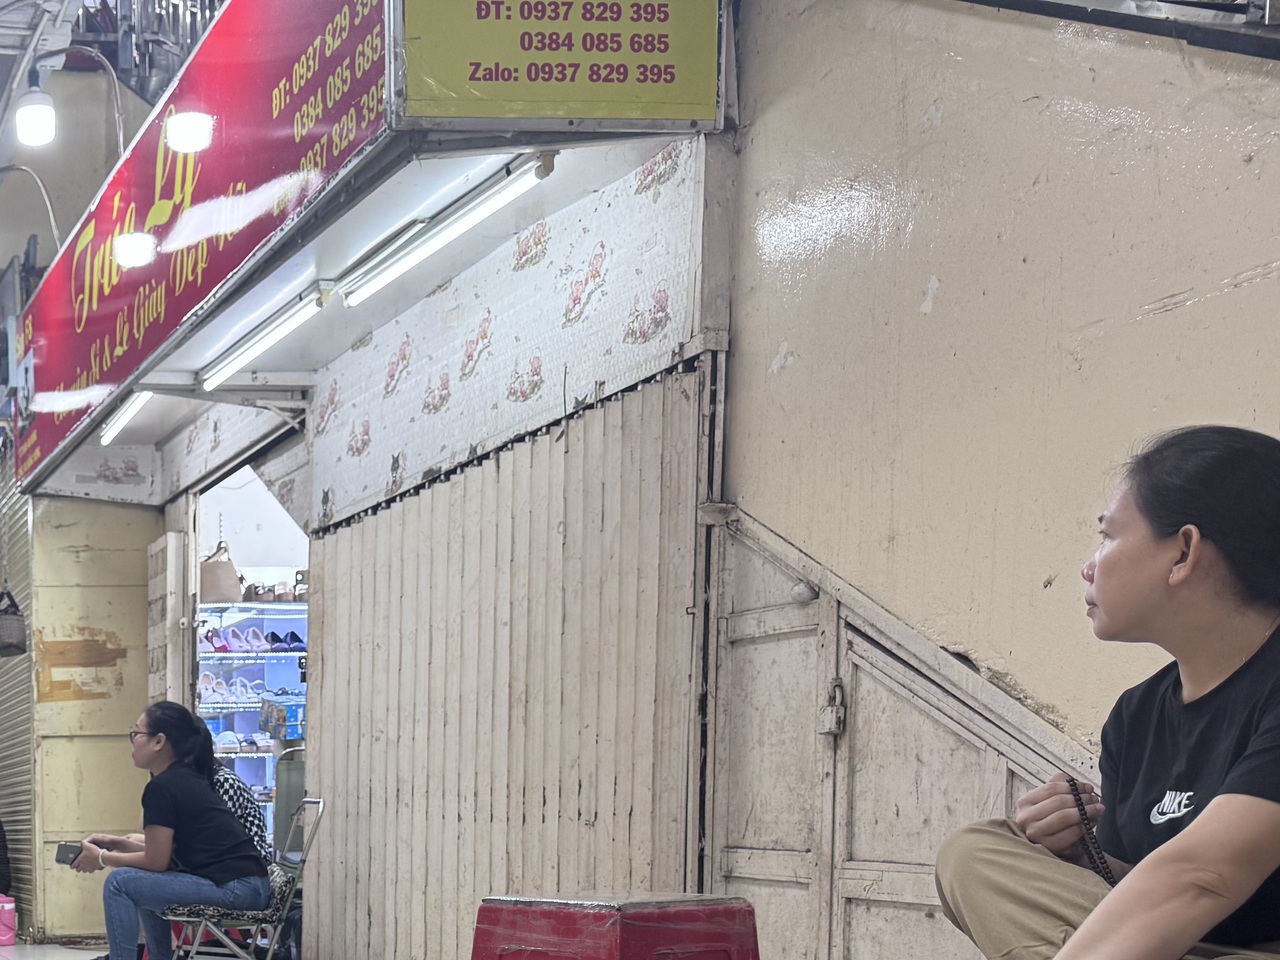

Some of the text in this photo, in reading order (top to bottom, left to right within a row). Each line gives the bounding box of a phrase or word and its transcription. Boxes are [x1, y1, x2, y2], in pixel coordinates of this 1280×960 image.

[476, 0, 670, 23] ĐT: 0937 829 395
[272, 76, 290, 120] ĐT:
[292, 35, 321, 94] 0937
[325, 4, 350, 58] 829
[520, 31, 670, 53] 0384 085 685
[293, 23, 382, 143] 0384 085 685
[468, 62, 676, 84] Zalo: 0937 829 395
[332, 106, 356, 157] 829
[360, 75, 385, 129] 395
[133, 278, 166, 350] Giày
[1158, 790, 1195, 814] NIKE
